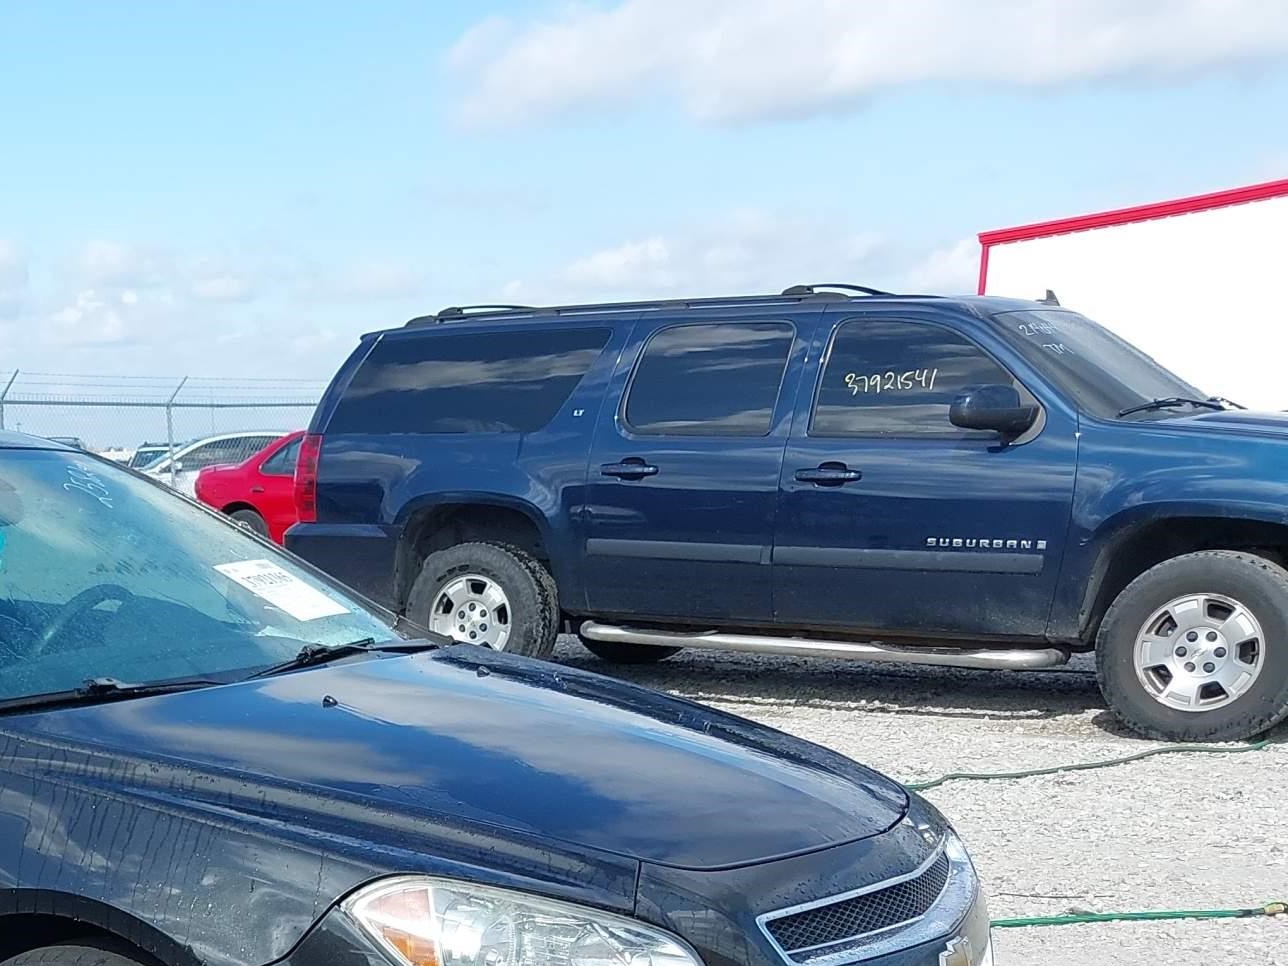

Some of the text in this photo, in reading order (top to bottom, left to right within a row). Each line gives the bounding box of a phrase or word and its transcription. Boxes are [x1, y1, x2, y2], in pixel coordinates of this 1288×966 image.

[844, 368, 938, 396] 37921541
[573, 409, 584, 417] LT
[926, 537, 1032, 549] SUBURBAN
